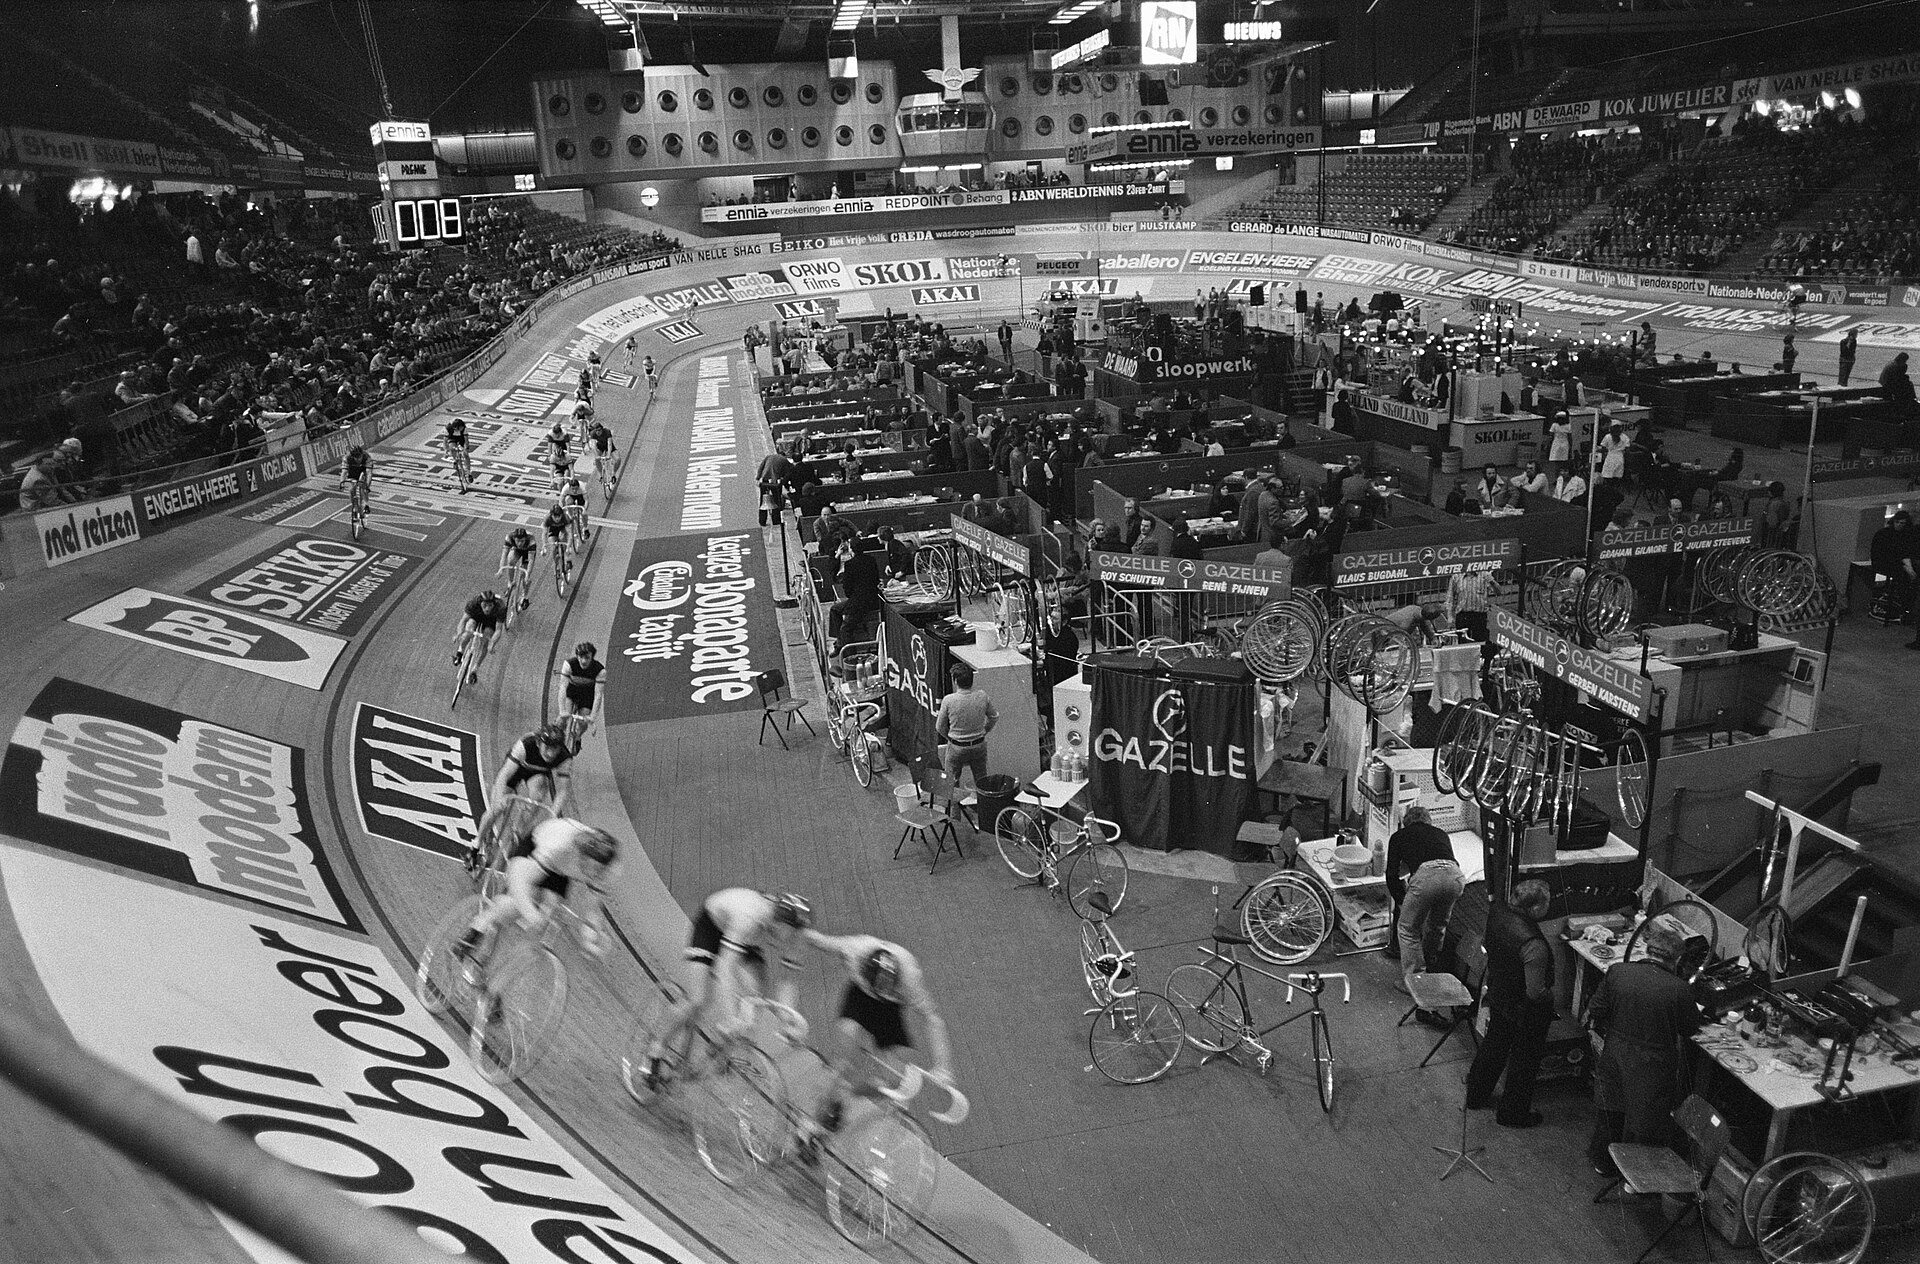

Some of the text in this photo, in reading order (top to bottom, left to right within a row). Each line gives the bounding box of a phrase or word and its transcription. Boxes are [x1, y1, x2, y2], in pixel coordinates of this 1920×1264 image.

[1224, 21, 1282, 41] NIEUWS
[1774, 74, 1807, 92] VAN
[1533, 102, 1590, 121] DE WAARD
[1605, 85, 1727, 117] KOK JUWELIER
[1423, 121, 1440, 139] 7UP
[1475, 115, 1492, 125] Bank
[1493, 111, 1522, 131] ABN
[385, 124, 426, 138] ennia
[1127, 128, 1315, 154] ennia verzekeringen
[20, 132, 89, 161] Shell
[886, 191, 1004, 210] REDPOINT Behang
[1019, 185, 1124, 202] ABN WERELDTENNIS
[726, 199, 875, 221] ennia verzekeringen ennia
[890, 226, 1015, 242] CREDA wasdroogautomaten
[1079, 221, 1134, 233] SKOL bier
[1139, 221, 1197, 231] HULSTKAMP
[1230, 222, 1273, 234] GERARD
[1284, 225, 1319, 237] LANGE
[1320, 228, 1369, 243] WASAUTOMATEN
[772, 238, 825, 253] SEIKO
[829, 233, 887, 247] Het Vrije Volk
[1373, 235, 1401, 248] ORWO
[1404, 239, 1423, 253] films
[648, 257, 669, 272] sport
[674, 245, 762, 265] VAN NELLE SHAG
[1036, 261, 1081, 270] PEUGEOT
[1099, 253, 1180, 270] caballero
[1189, 251, 1317, 270] ENGELEN-HEERE
[1326, 257, 1393, 273] Shell
[593, 264, 628, 284] TRANSAVIA
[788, 260, 842, 279] ORWO
[854, 260, 942, 287] SKOL
[1314, 266, 1380, 286] Shell
[1389, 262, 1452, 285] KOK
[1528, 264, 1570, 280] Shell
[1578, 271, 1636, 288] Het Vrije Volk
[728, 273, 774, 288] radio
[803, 276, 841, 291] films
[1451, 269, 1525, 293] ABN
[653, 284, 729, 314] GAZELLE
[729, 282, 794, 302] modern
[918, 286, 975, 304] AKAI
[1103, 351, 1138, 378] DE WAARD
[1382, 400, 1429, 426] SKOLLAND
[689, 406, 737, 454] TRANSAVIA
[1475, 429, 1533, 444] SKOL bier
[262, 452, 297, 482] KOELING
[1812, 460, 1859, 474] GAZELLE
[143, 471, 240, 521] ENGELEN-HEERE
[680, 454, 738, 530] Neckermann
[83, 506, 136, 549] reizen
[1602, 518, 1754, 547] GAZELLE GAZELLE
[953, 517, 1026, 562] GAZELLE GAZELLE
[1600, 535, 1752, 560] GRAHAM GILMORE 12 JULIEN STEEVENS
[1342, 541, 1511, 570] GAZELLE GAZELLE
[210, 539, 368, 620] SEIKO
[1100, 554, 1284, 584] GAZELLE GAZELLE
[1336, 559, 1503, 585] KLAUS BUGDAHL 4 DIETER KEMPER
[306, 599, 358, 631] Modern
[336, 572, 381, 604] Masters
[387, 554, 409, 572] Time
[1100, 570, 1117, 581] ROY
[1118, 572, 1166, 586] SCHUITEN
[1231, 583, 1269, 597] PIJNEN
[144, 608, 263, 657] BP
[622, 613, 685, 662] tapijt
[677, 578, 763, 704] Bonaparte
[1496, 611, 1643, 699] GAZELLE GAZELLE
[1496, 632, 1641, 719] LEO DUYNDAM 9 GERBEN KARSTENS
[1094, 727, 1248, 780] GAZELLE
[39, 720, 171, 842] radio
[361, 714, 480, 850] AKAI
[168, 727, 317, 910] modern
